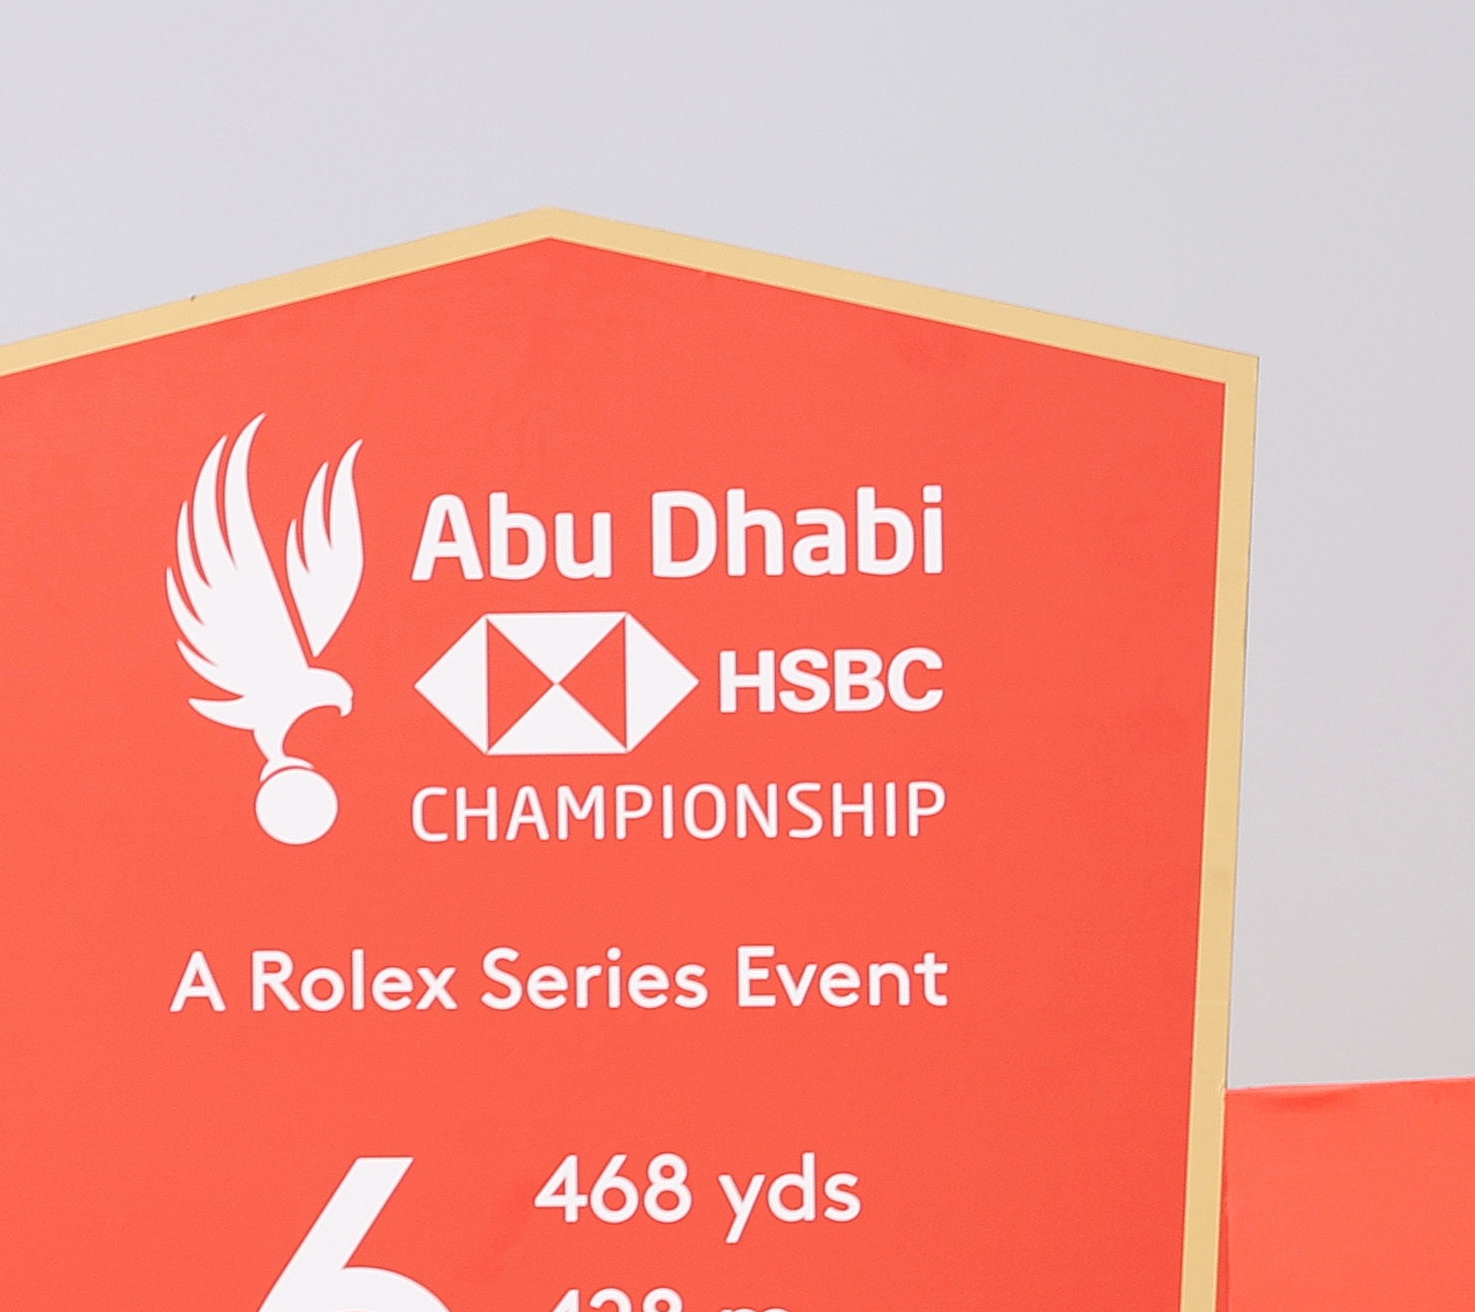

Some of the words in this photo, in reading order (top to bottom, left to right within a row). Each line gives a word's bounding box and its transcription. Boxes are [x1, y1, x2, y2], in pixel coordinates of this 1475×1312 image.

[410, 491, 613, 582] Abu
[650, 484, 944, 579] Dhabi
[718, 646, 944, 714] HSBC
[411, 780, 947, 843] CHAMPIONSHIP
[168, 949, 227, 1013] A
[251, 947, 459, 1013] Rolex
[480, 946, 709, 1011] Series
[736, 944, 949, 1008] Event
[533, 1152, 693, 1224] 468
[717, 1151, 862, 1245] yds
